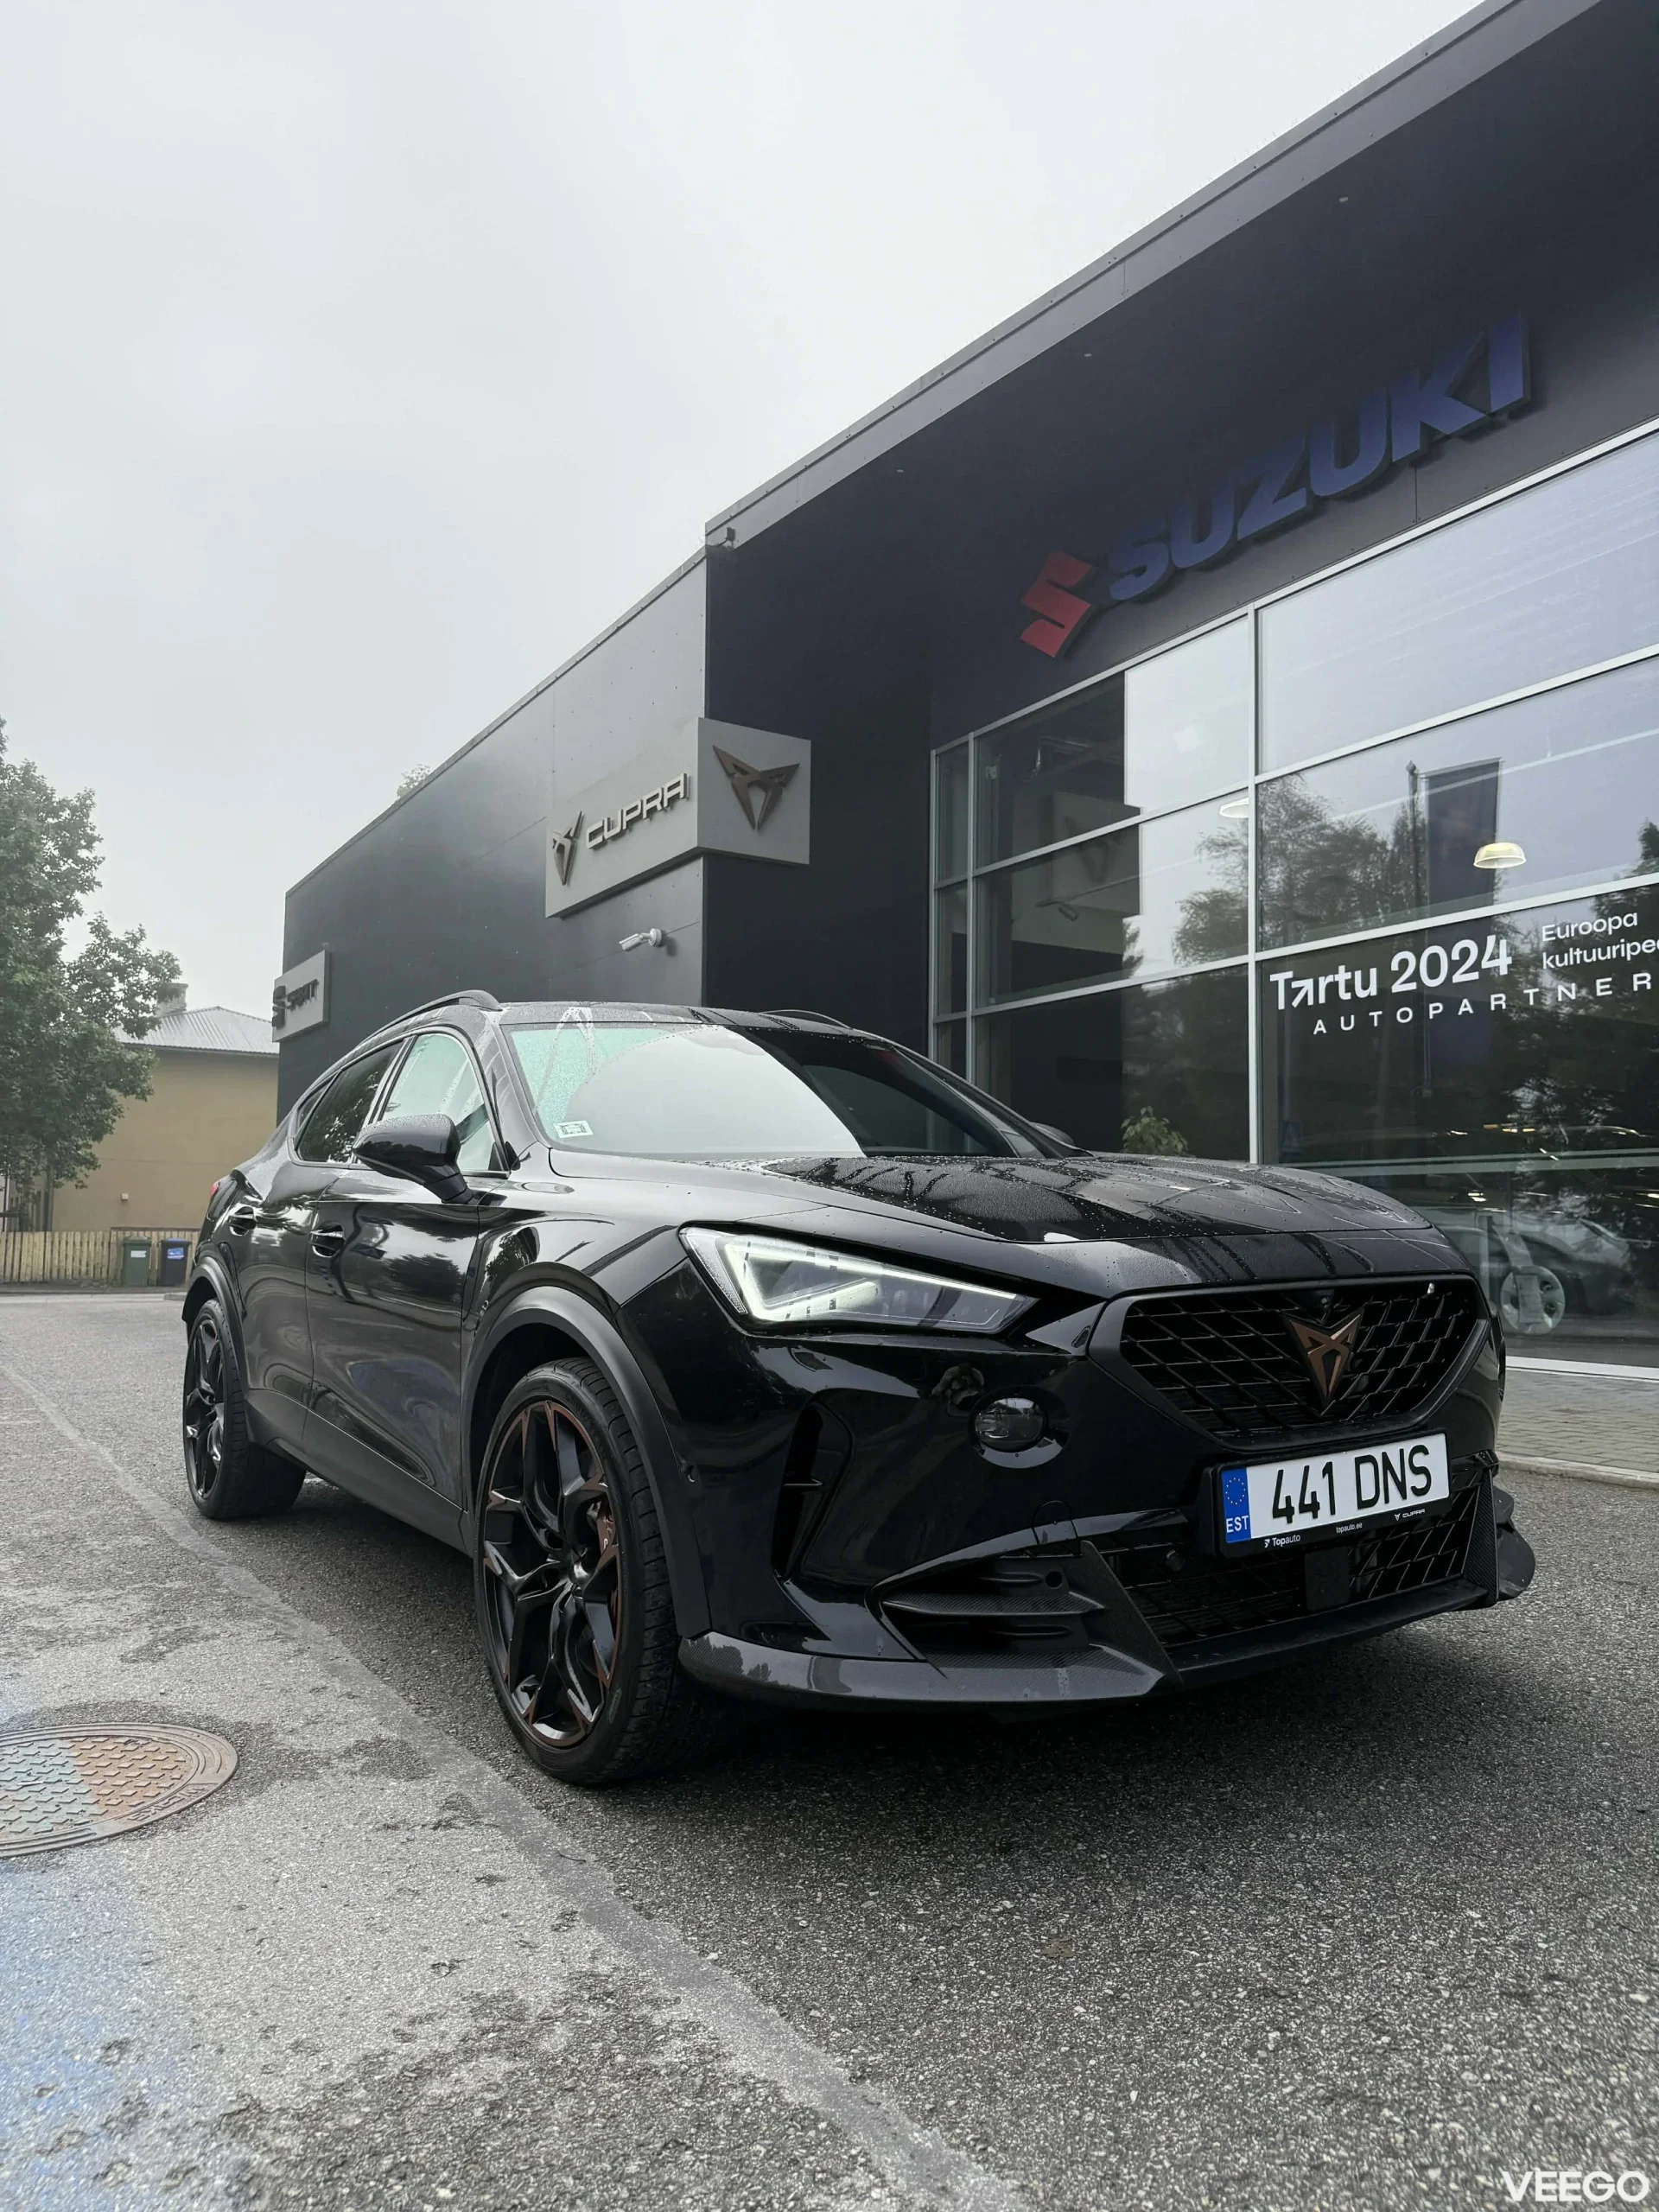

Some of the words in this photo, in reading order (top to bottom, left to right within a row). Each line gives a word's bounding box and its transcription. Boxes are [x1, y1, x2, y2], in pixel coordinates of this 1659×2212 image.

[1108, 315, 1527, 601] SUZUKI
[586, 772, 689, 850] CUPRA
[1541, 912, 1638, 942] Euroopa
[1542, 938, 1659, 969] kultuuripe
[1269, 964, 1377, 1010] Tartu
[1390, 935, 1513, 994] 2024
[1313, 972, 1652, 1035] AUTOPARTNER
[1272, 1461, 1337, 1524] 441
[1354, 1444, 1433, 1510] DNS
[1226, 1515, 1249, 1534] EST
[1336, 1522, 1363, 1534] topauto.ee
[1402, 1508, 1426, 1518] CUPRA
[1271, 1534, 1301, 1548] Topauto
